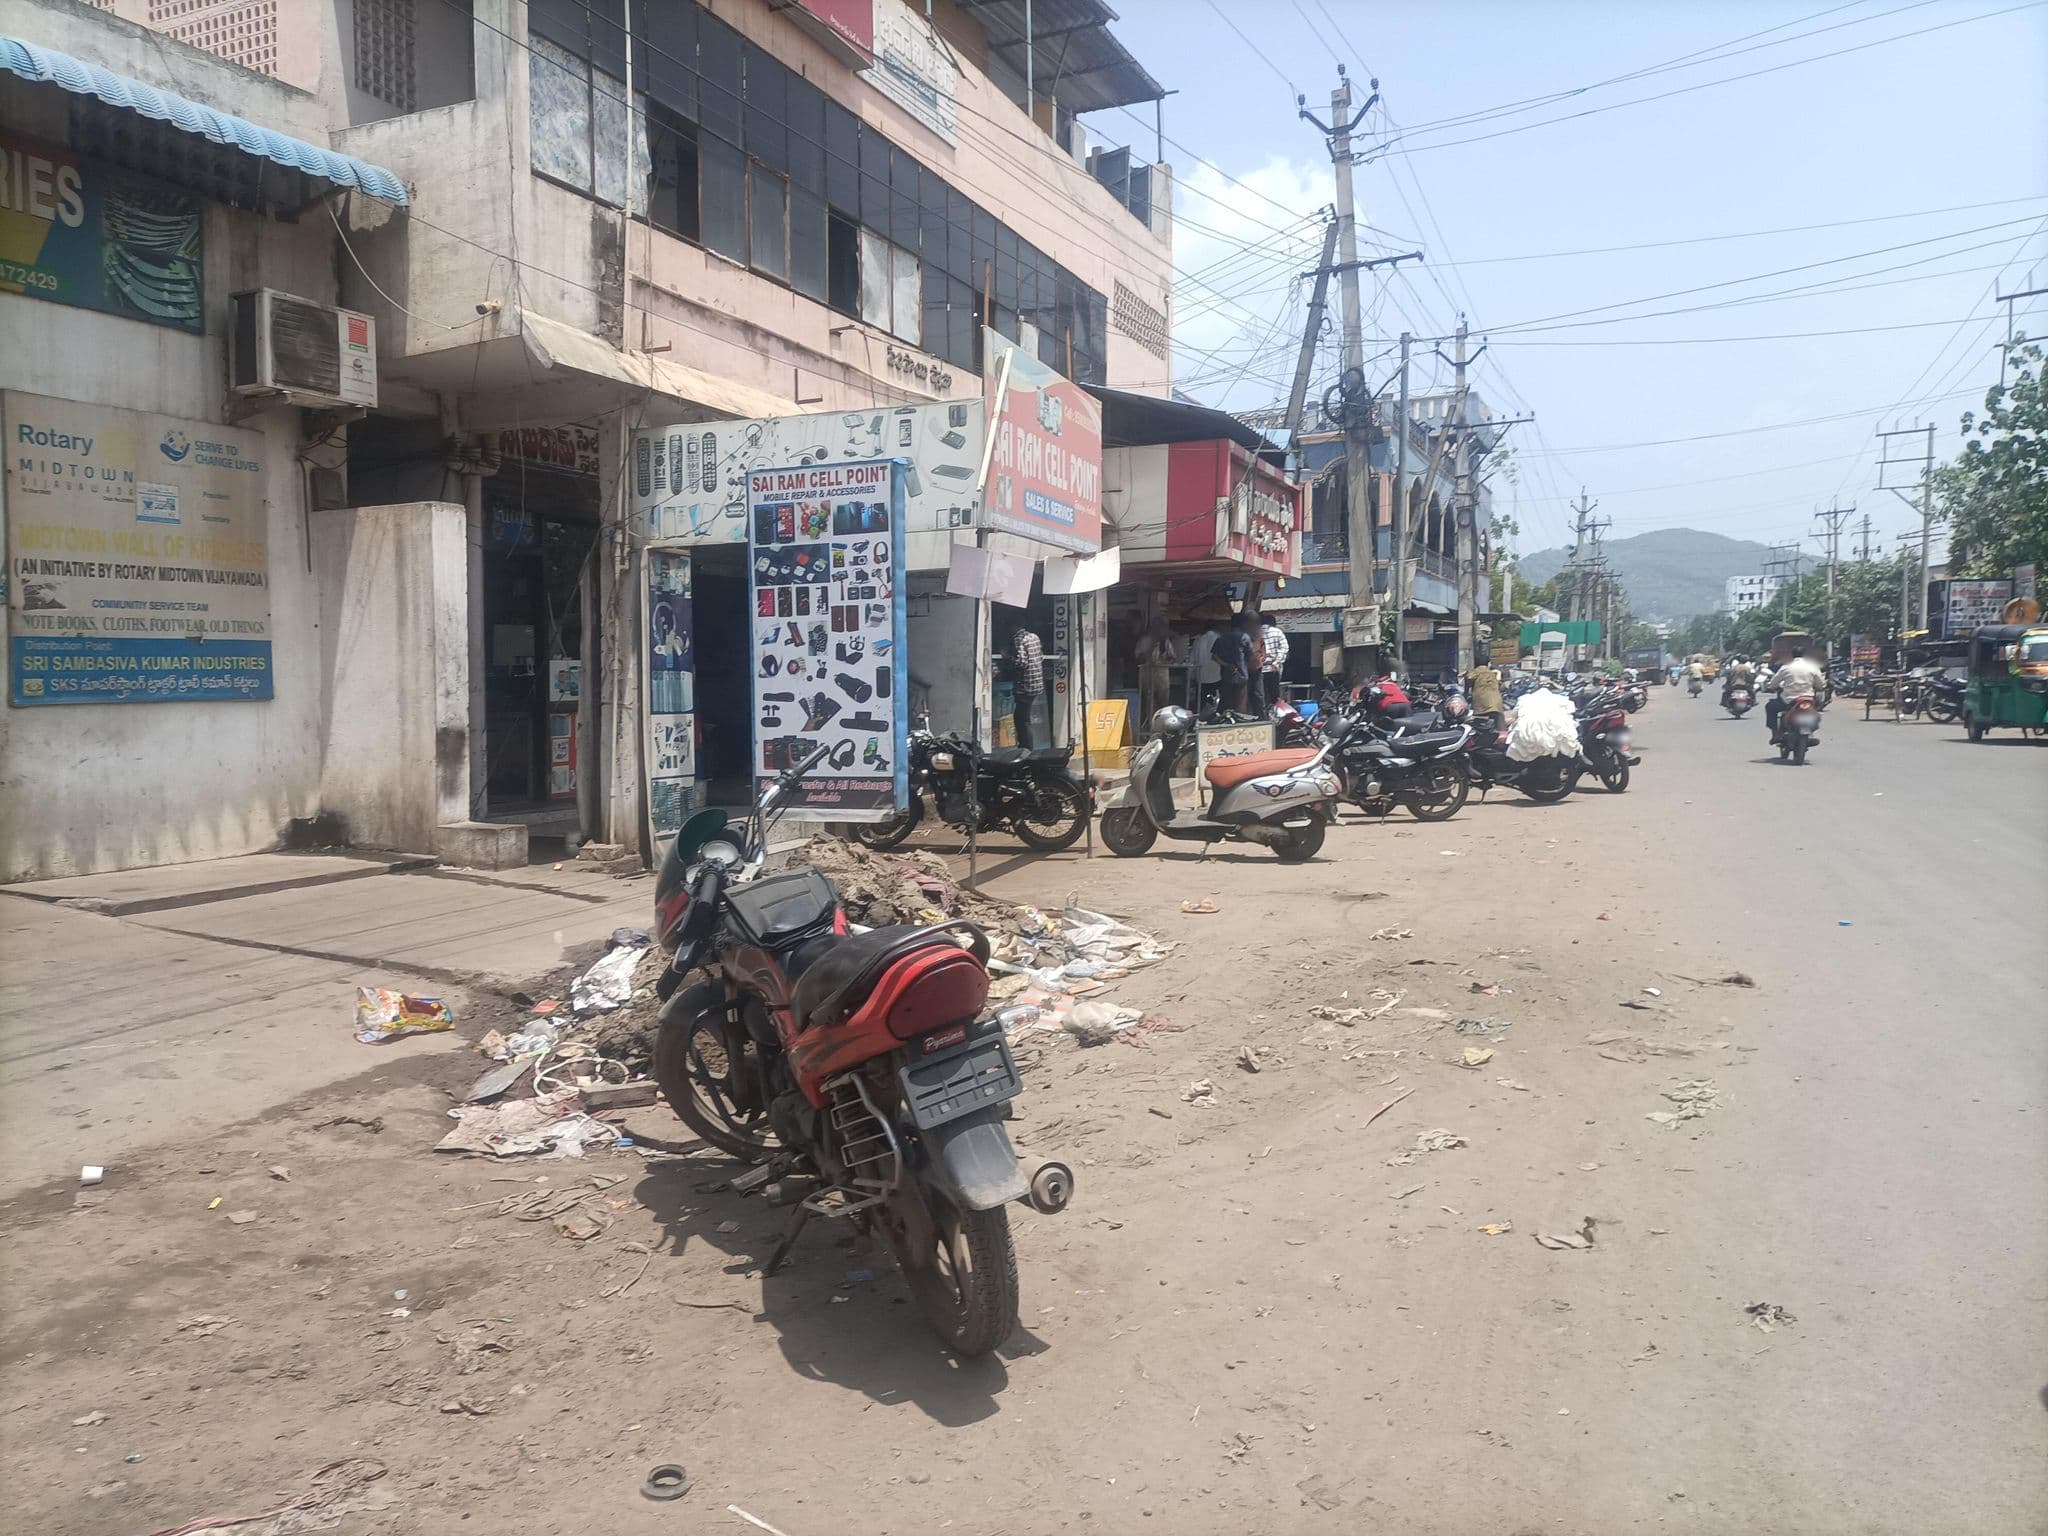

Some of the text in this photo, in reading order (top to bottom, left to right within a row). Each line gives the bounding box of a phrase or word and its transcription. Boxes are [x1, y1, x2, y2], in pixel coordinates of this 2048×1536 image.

[18, 423, 93, 456] Rotary
[194, 440, 238, 456] SERVE TO
[19, 458, 134, 483] MIDTOWN
[195, 454, 233, 469] CHANGE
[235, 460, 260, 472] LIVES
[752, 466, 888, 493] SAI RAM CELL POINT
[1045, 442, 1068, 491] CELL
[1071, 454, 1098, 503] POINT
[763, 485, 876, 502] MOBILE REPAIR & ACCESSORIES
[1025, 491, 1045, 513] SALES
[1050, 500, 1074, 523] SERVICE
[40, 559, 95, 579] INITIATIVE
[98, 563, 114, 580] BY
[115, 564, 157, 582] ROTARY
[159, 566, 204, 584] MIDTOWN
[92, 599, 209, 612] COMMUNITY SERVICE TEAM
[23, 614, 53, 631] NOTE
[23, 656, 266, 671] SRI SAMBASIVA KUMAR INDUSTRIES
[51, 678, 77, 692] SKS
